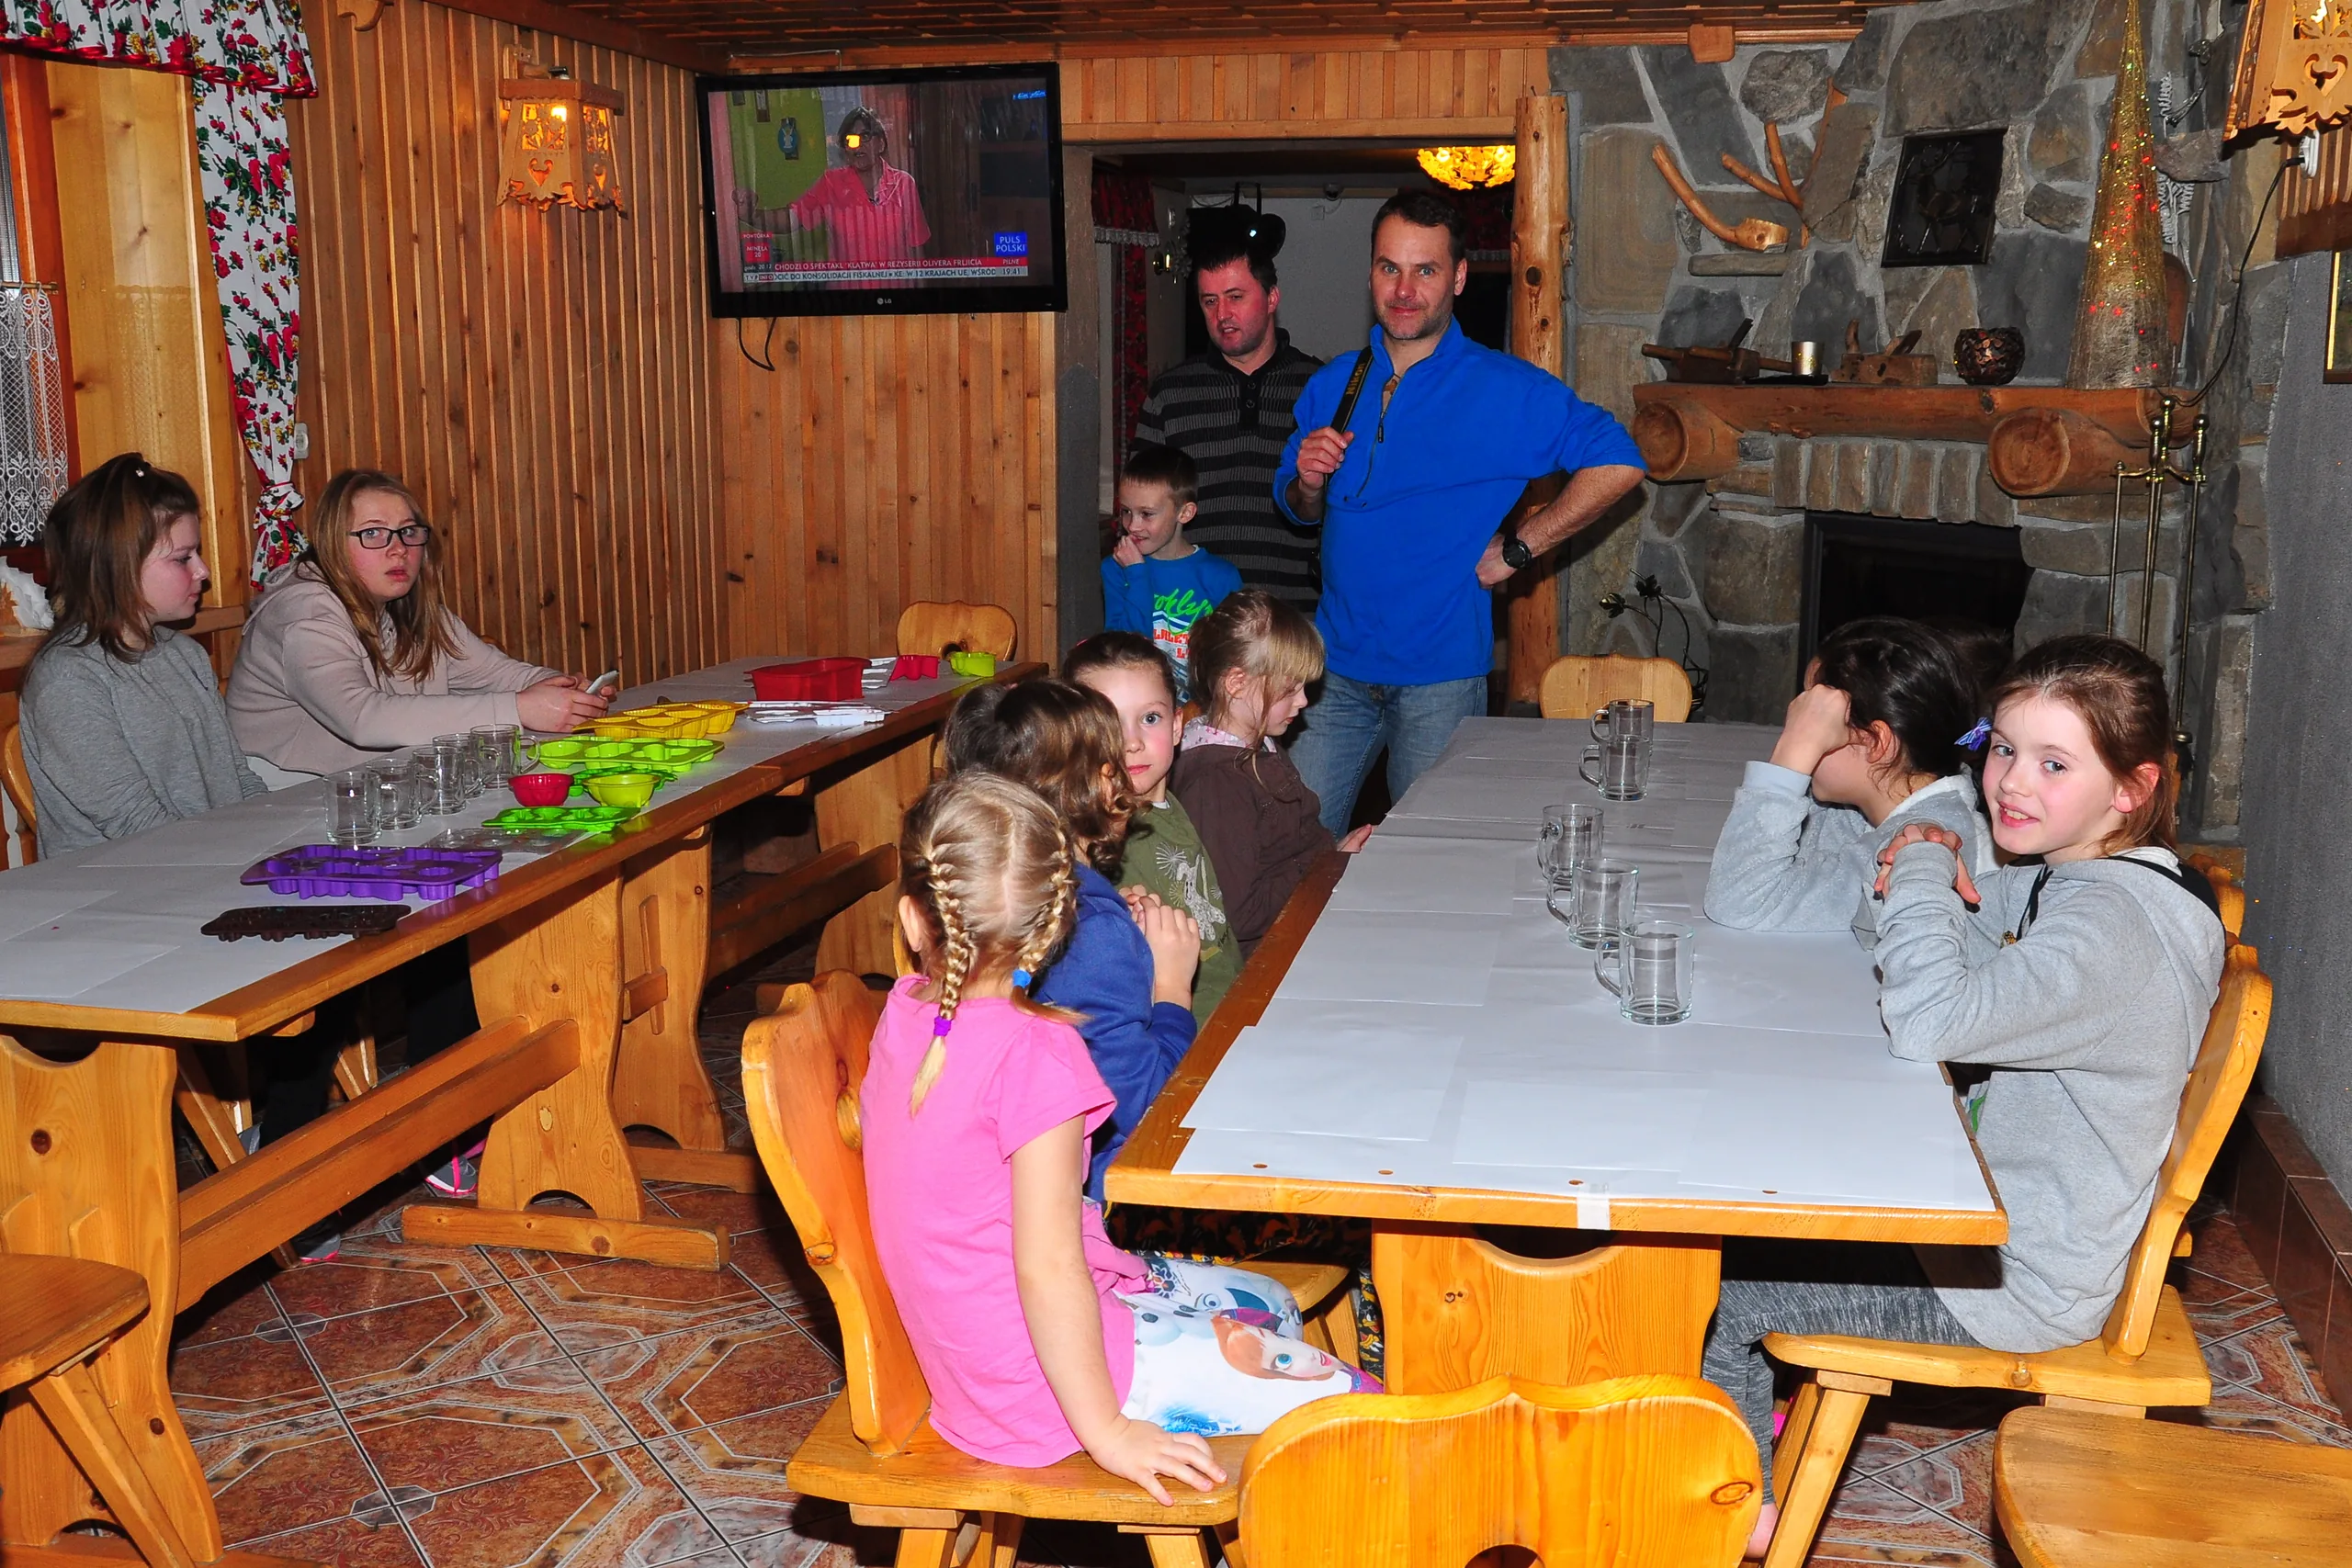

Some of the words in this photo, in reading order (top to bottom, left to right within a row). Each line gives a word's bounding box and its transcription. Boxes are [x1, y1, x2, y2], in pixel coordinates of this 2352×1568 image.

[996, 244, 1025, 253] POLSKI
[803, 271, 852, 279] KONSOLIDACJI
[854, 270, 888, 278] FISKALNEJ
[924, 268, 957, 276] KRAJACH
[1345, 363, 1366, 395] Nikon
